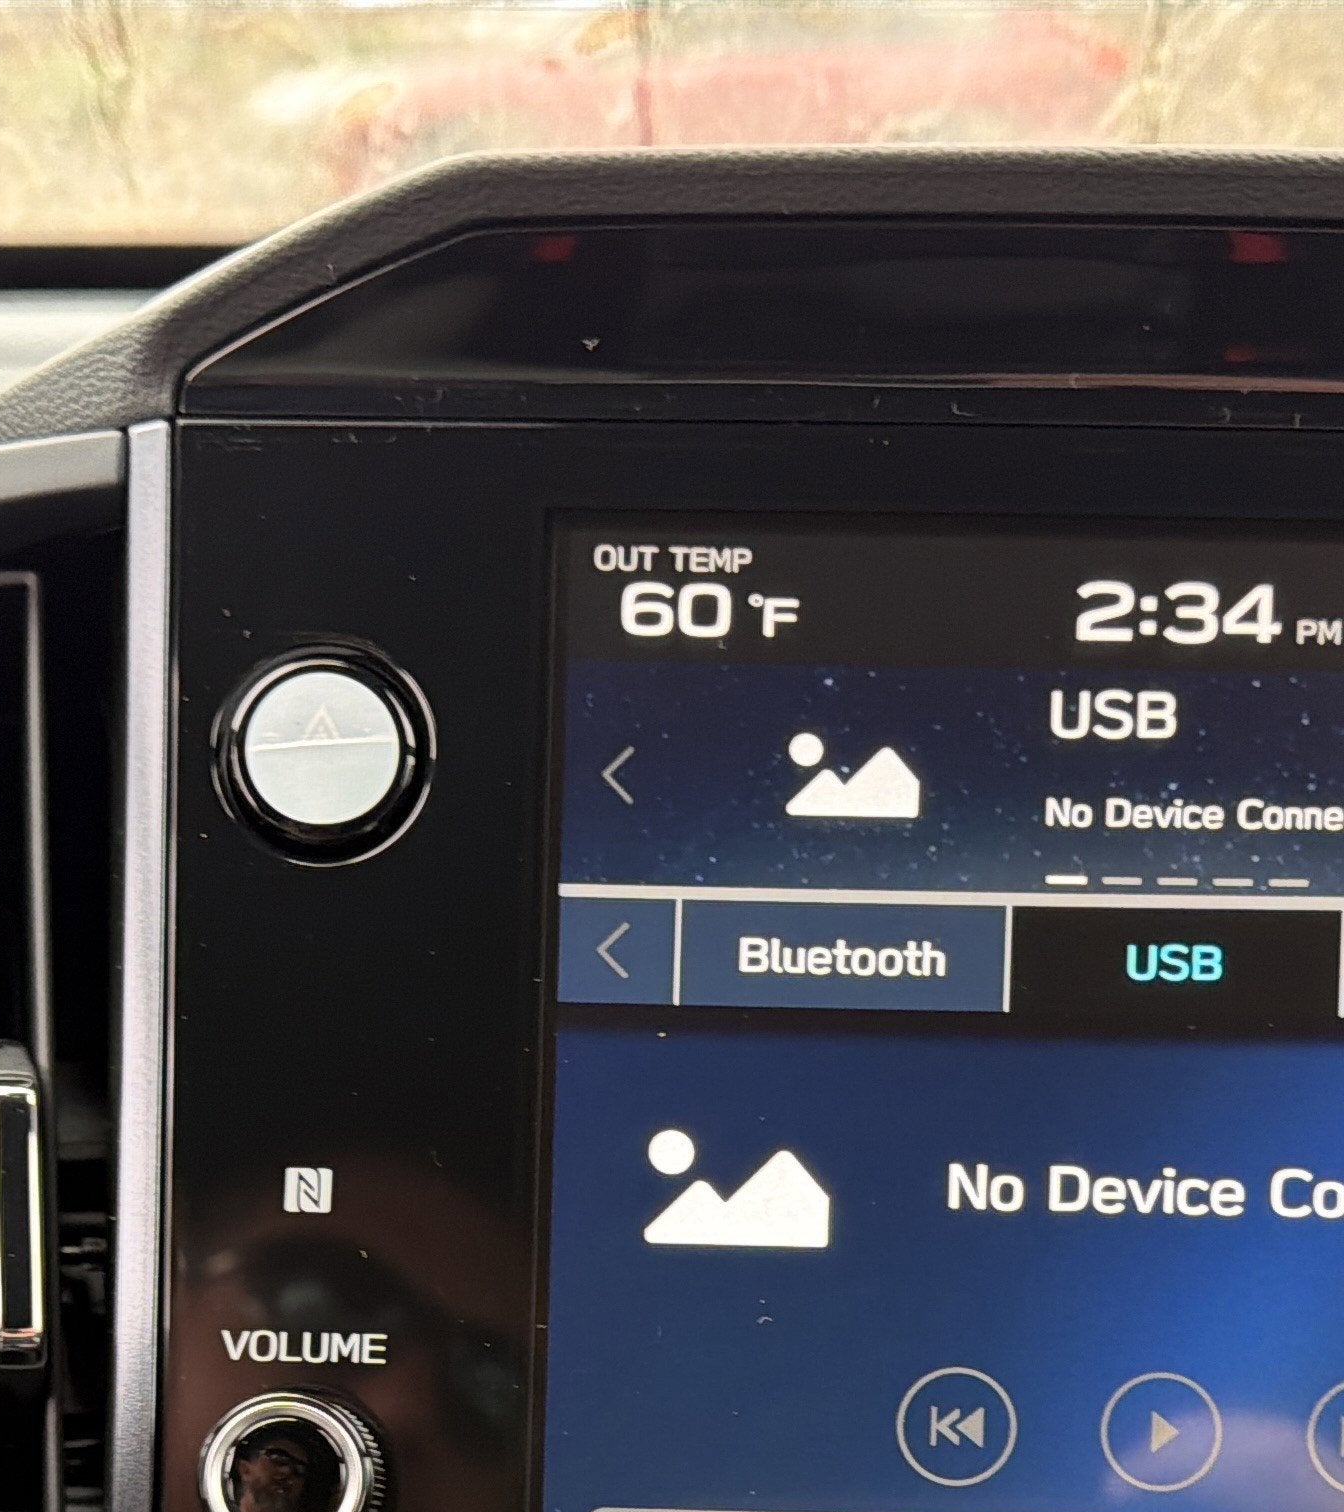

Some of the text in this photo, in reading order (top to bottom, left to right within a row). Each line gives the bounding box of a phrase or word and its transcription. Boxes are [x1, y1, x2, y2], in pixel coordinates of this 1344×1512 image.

[593, 543, 753, 574] OUT TEMP
[619, 581, 732, 638] 60
[1075, 580, 1343, 646] 2:34 PM
[1050, 688, 1178, 740] USB
[1044, 796, 1094, 829] No
[1105, 797, 1225, 830] Device
[738, 936, 946, 977] Bluetooth
[1126, 943, 1223, 982] USB
[947, 1162, 1025, 1213] No
[1048, 1164, 1246, 1217] Device
[220, 1329, 388, 1364] VOLUME
